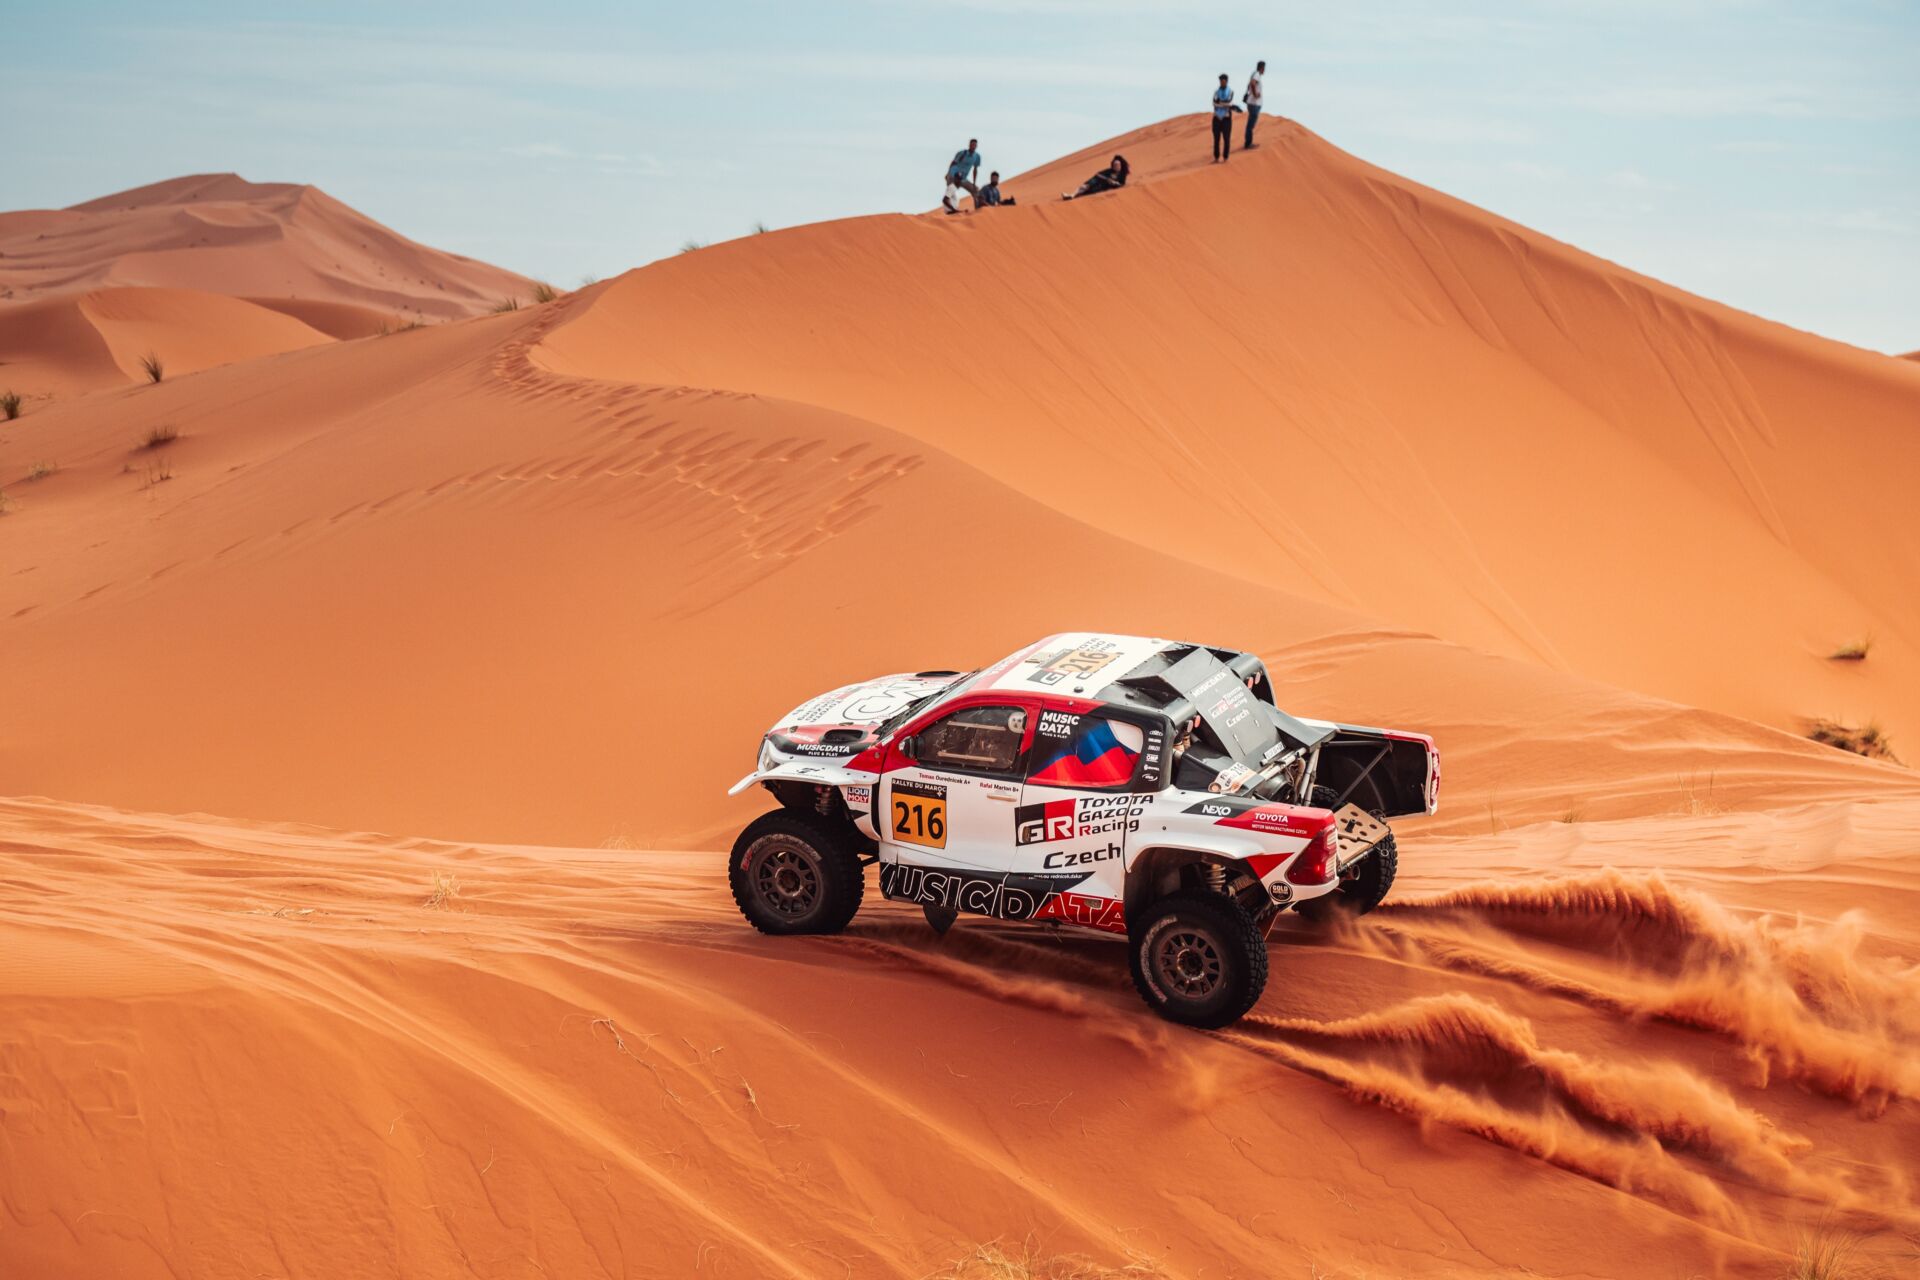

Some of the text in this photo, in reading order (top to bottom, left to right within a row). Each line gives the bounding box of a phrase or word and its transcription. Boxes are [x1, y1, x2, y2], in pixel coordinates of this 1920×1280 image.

[1059, 651, 1110, 672] 216
[1042, 711, 1080, 726] MUSIC
[1226, 709, 1250, 728] Czech
[1039, 721, 1071, 735] DATA
[797, 744, 850, 753] MUSICDATA
[848, 788, 869, 796] LIQUI
[892, 779, 914, 788] RALLYE
[924, 784, 947, 792] MAROC
[848, 794, 869, 803] MOLY
[1079, 794, 1154, 809] TOYOTA
[1078, 807, 1144, 823] GAZOO
[1202, 804, 1232, 816] NEXO
[1254, 812, 1289, 823] TOYOTA
[895, 801, 944, 840] 216
[1079, 819, 1140, 837] Racing
[1016, 815, 1073, 844] GR
[1042, 842, 1121, 870] Czech
